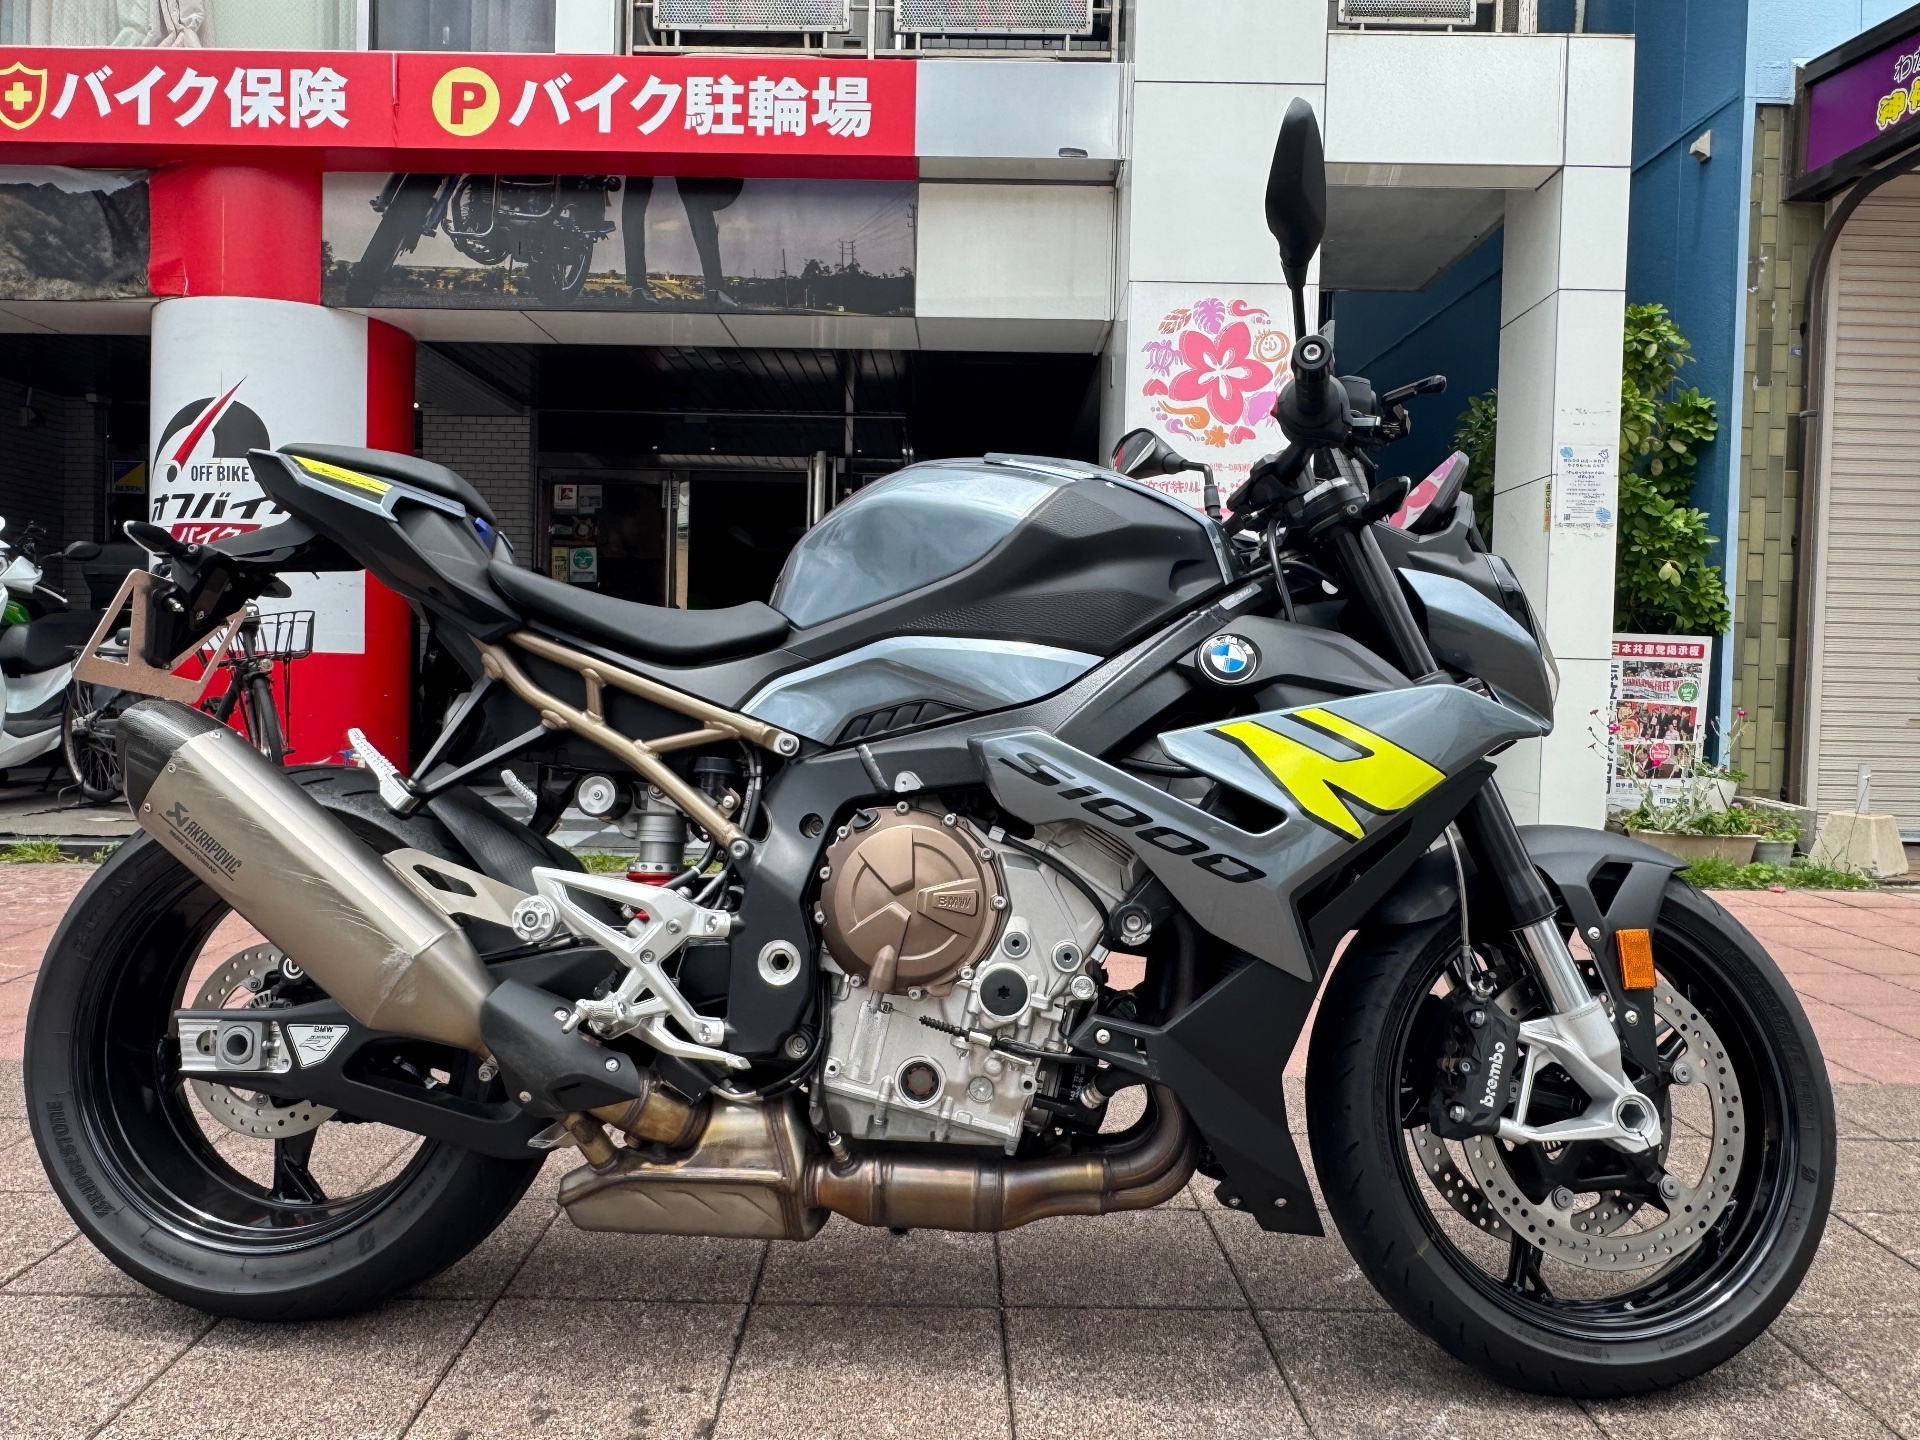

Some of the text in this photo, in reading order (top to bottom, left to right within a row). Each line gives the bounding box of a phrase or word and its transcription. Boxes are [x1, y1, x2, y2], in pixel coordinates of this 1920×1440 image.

[50, 65, 350, 129] バイク保険
[450, 82, 487, 124] P
[508, 72, 872, 138] バイク駐輪場
[191, 465, 250, 482] OFF BIKE
[998, 752, 1266, 883] S1000
[938, 895, 971, 909] BMW
[313, 1025, 334, 1033] BMW
[1480, 1041, 1506, 1108] brembo
